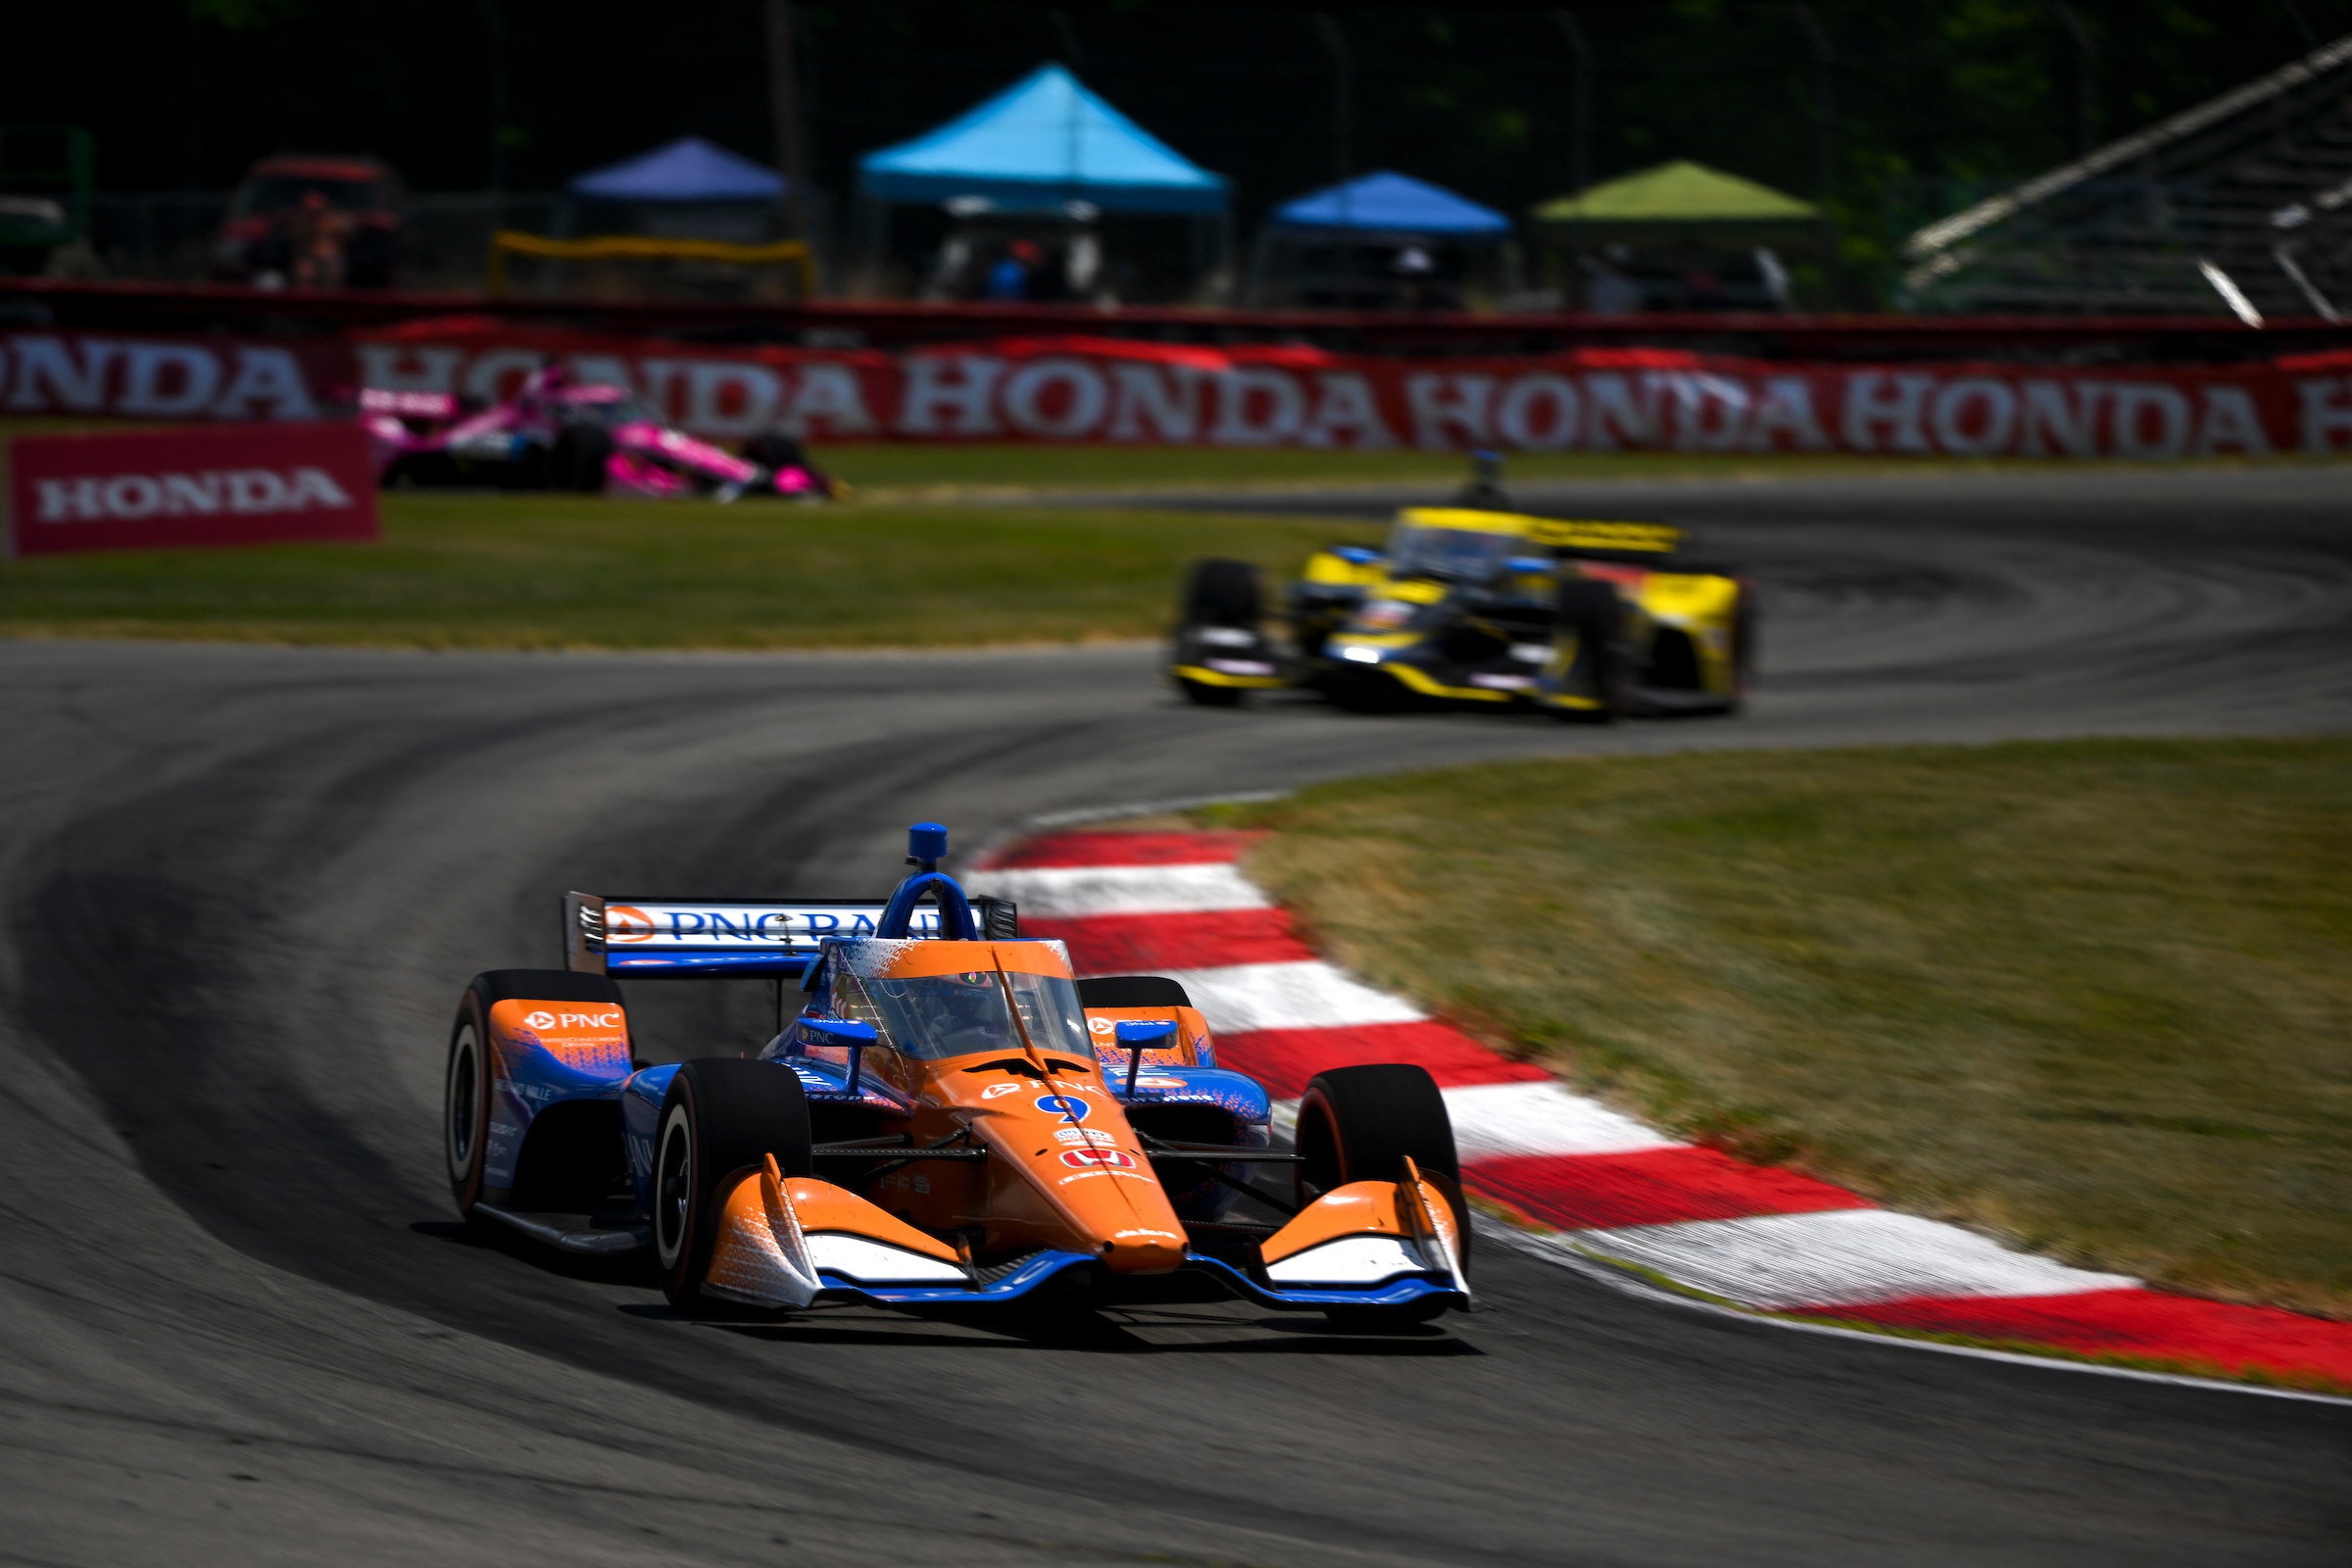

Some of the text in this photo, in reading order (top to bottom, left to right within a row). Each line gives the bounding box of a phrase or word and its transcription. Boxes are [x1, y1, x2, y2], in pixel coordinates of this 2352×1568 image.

[0, 334, 318, 418] NDA
[894, 355, 1394, 449] HONDA
[1405, 371, 1829, 452] HONDA
[1841, 372, 2272, 457] HONDA
[33, 466, 352, 521] HONDA
[558, 1013, 619, 1027] PNC
[809, 1032, 833, 1044] PNC
[1034, 1095, 1091, 1124] 9
